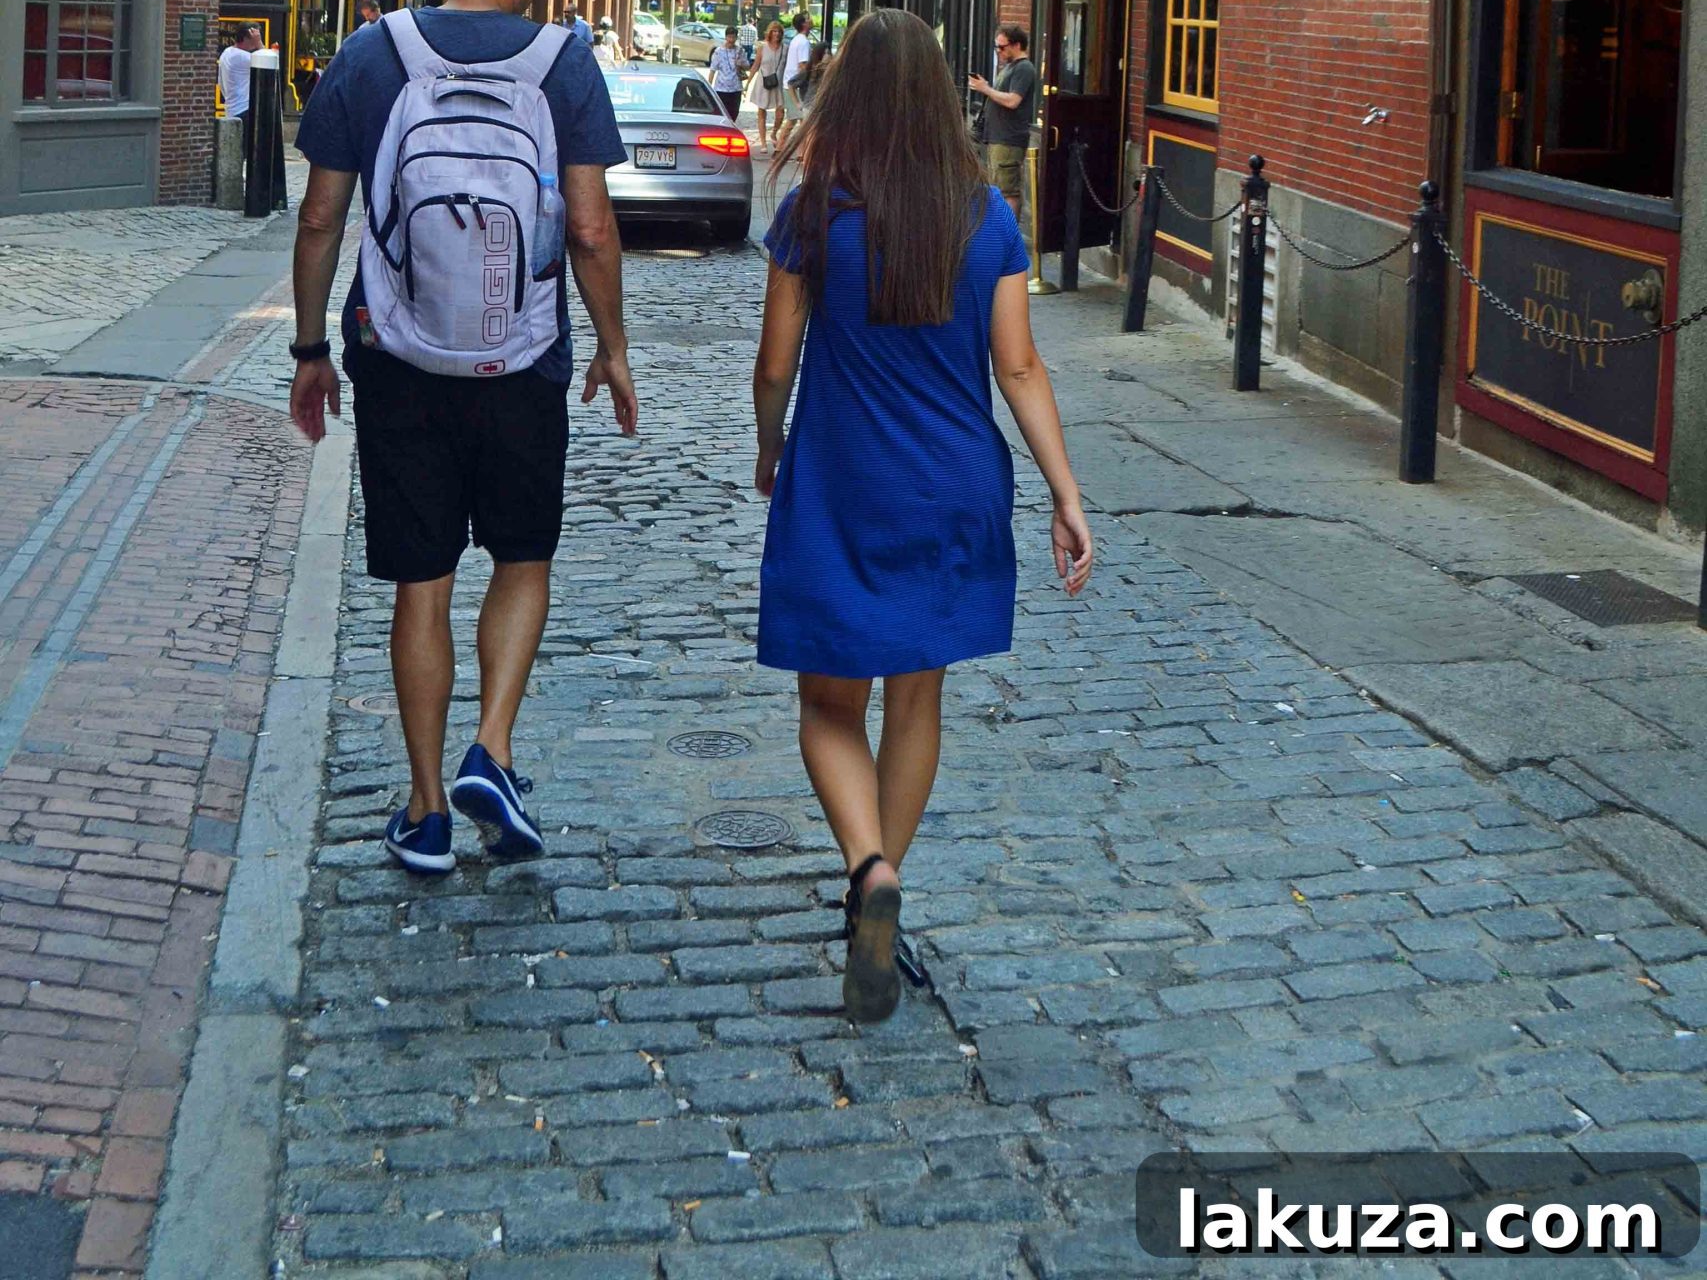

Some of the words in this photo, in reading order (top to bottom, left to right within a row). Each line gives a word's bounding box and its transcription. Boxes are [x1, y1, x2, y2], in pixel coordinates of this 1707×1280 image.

[638, 150, 654, 161] 797
[657, 150, 674, 162] VY8
[482, 212, 511, 345] OGIO
[1533, 263, 1571, 300] THE
[1521, 290, 1614, 390] POINT
